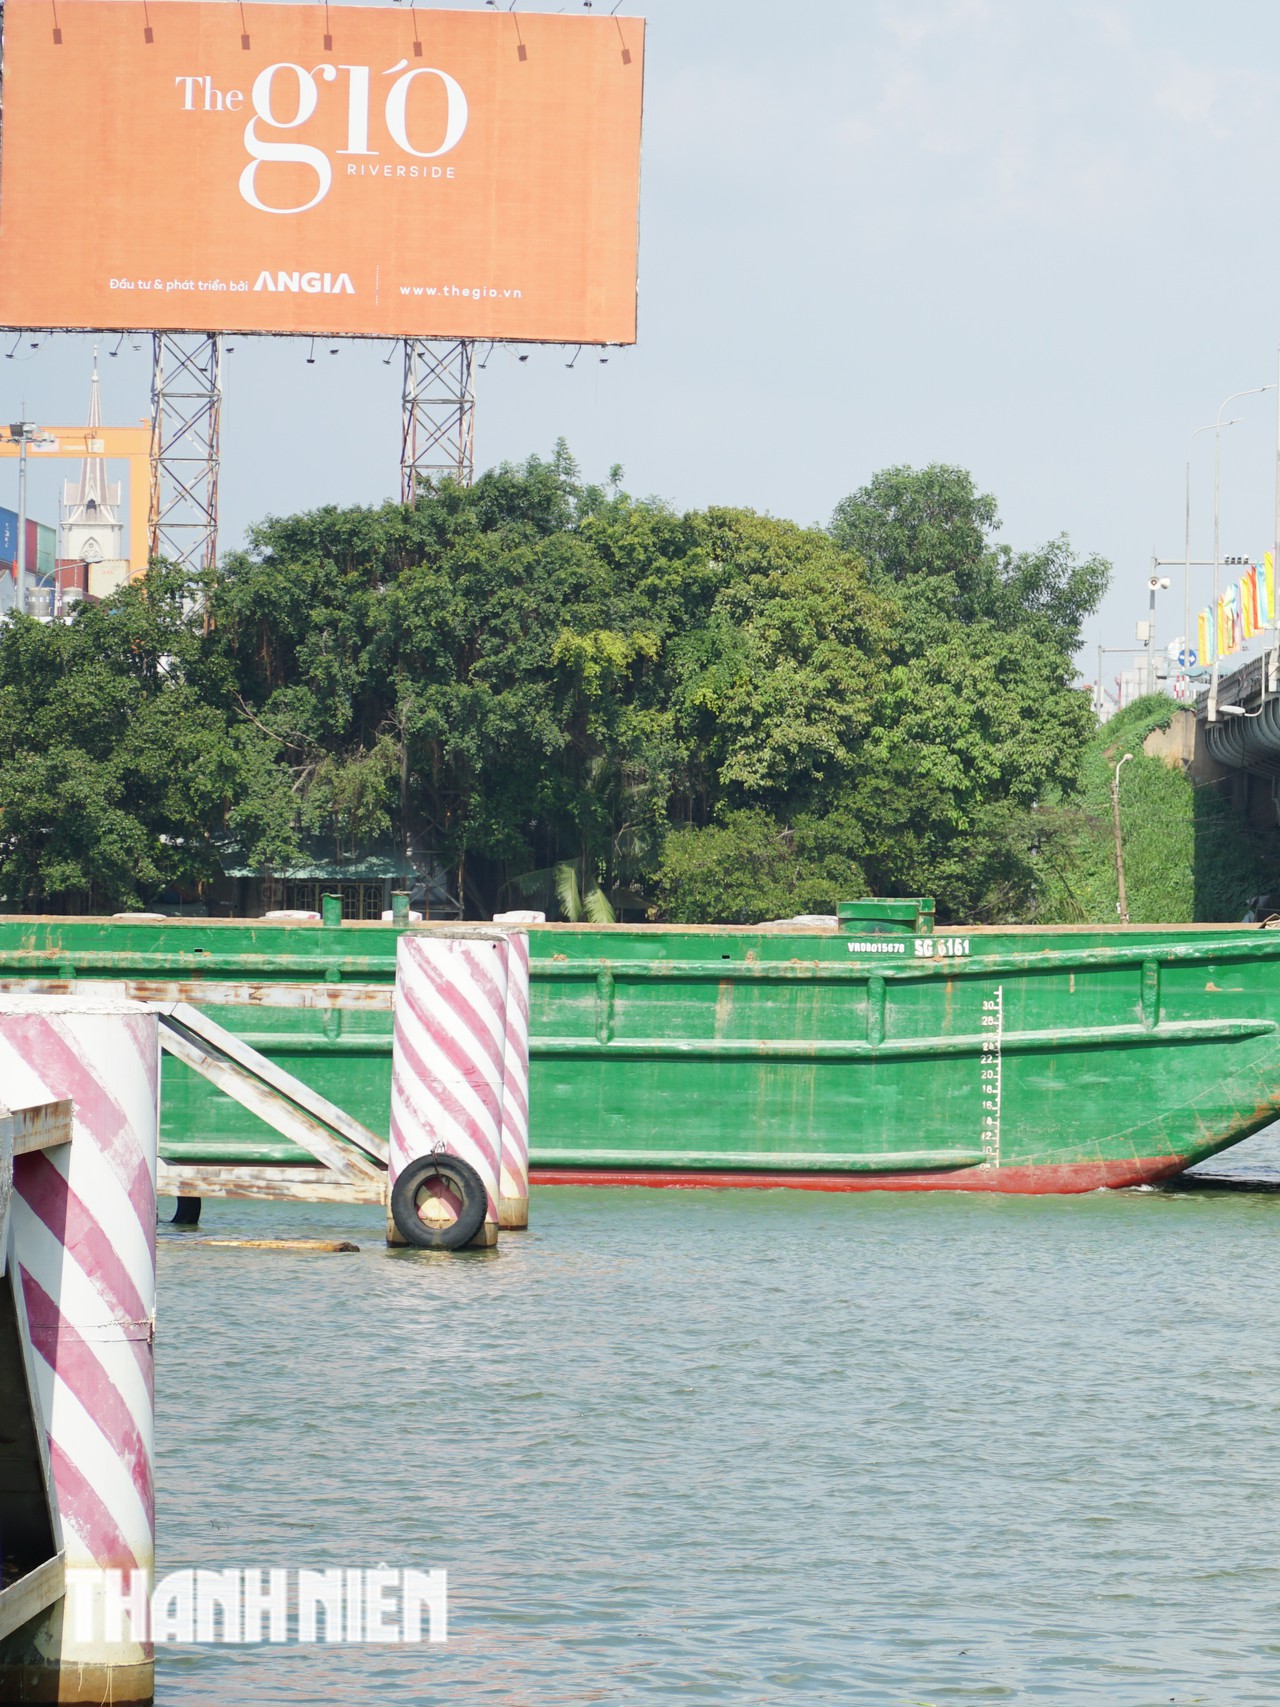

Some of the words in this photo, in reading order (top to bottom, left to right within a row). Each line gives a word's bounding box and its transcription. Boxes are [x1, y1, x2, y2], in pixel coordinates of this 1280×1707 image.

[175, 75, 244, 112] The
[347, 163, 456, 179] RIVERSIDE
[137, 279, 151, 290] tư
[153, 279, 163, 290] &
[166, 279, 195, 293] phát
[400, 284, 523, 300] www.thegio.vn
[914, 939, 934, 957] SG
[937, 938, 971, 957] 6161
[982, 1000, 995, 1011] 30
[980, 1054, 993, 1065] 22
[980, 1070, 994, 1080] 20
[982, 1084, 993, 1094] 18
[982, 1101, 993, 1110] 16
